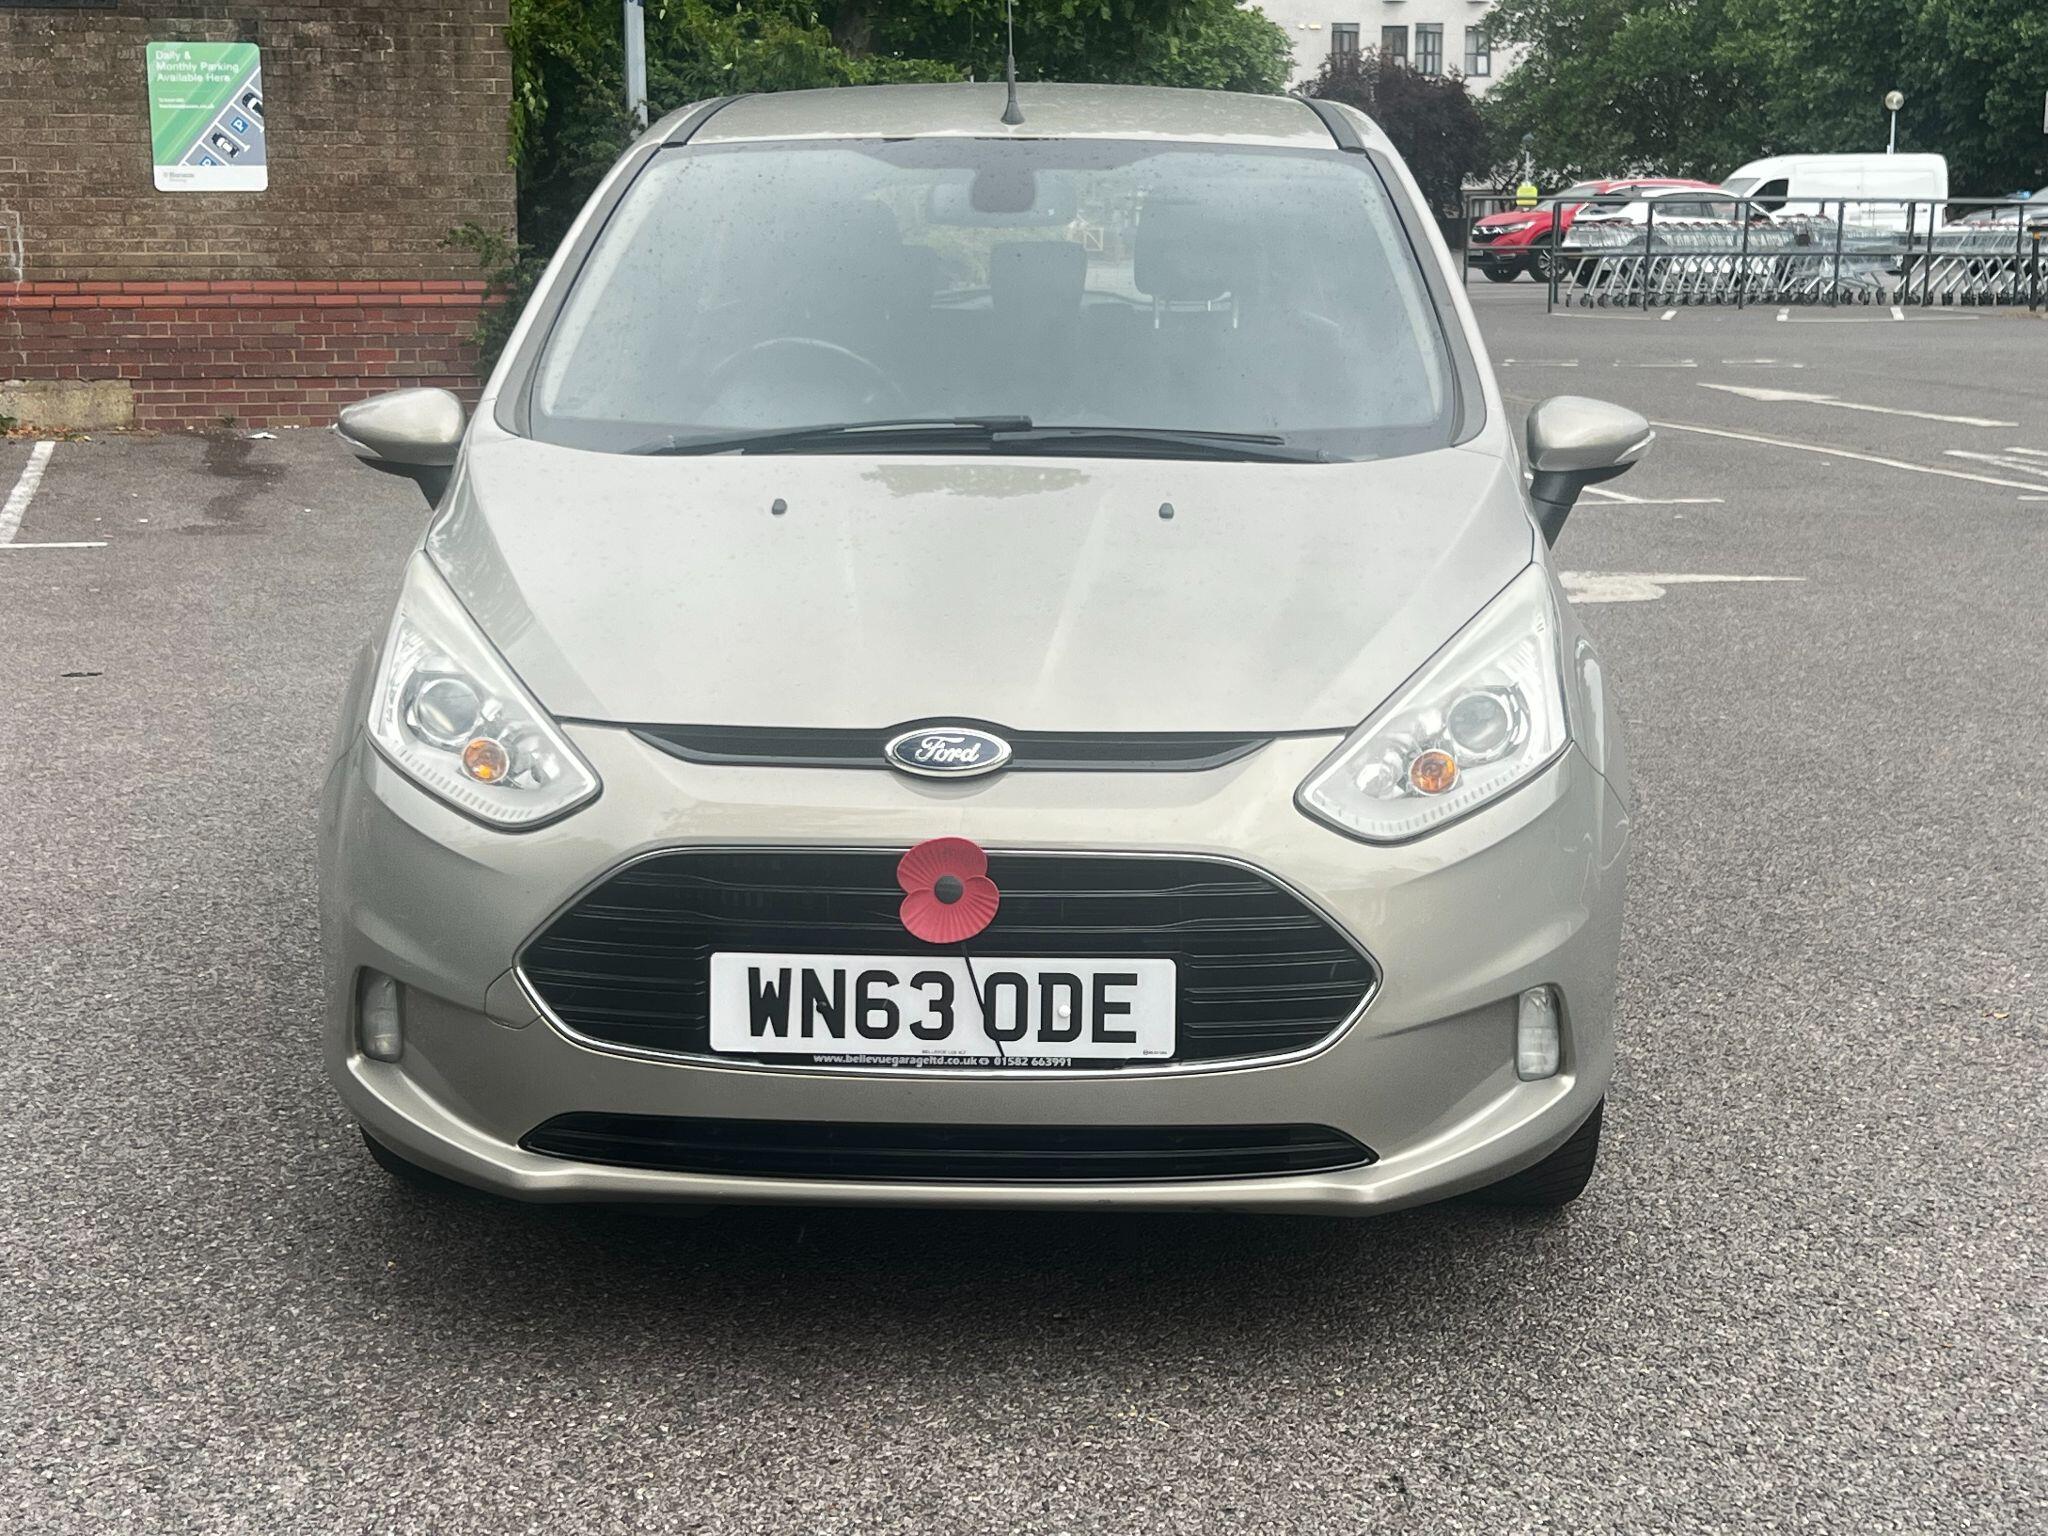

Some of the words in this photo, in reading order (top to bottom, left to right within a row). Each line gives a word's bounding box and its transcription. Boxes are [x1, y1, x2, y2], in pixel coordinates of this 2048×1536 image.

[155, 50, 180, 61] Daily
[184, 51, 191, 60] &
[156, 61, 197, 72] Monthly
[200, 62, 239, 73] Parking
[157, 72, 203, 82] Available
[206, 73, 231, 82] Here
[914, 736, 981, 762] Ford
[748, 967, 954, 1040] WN63
[984, 972, 1138, 1043] ODE
[813, 1054, 977, 1067] www.bellevuegarageltd.co.uk
[994, 1057, 1028, 1066] 01582
[1031, 1058, 1072, 1067] 663991
